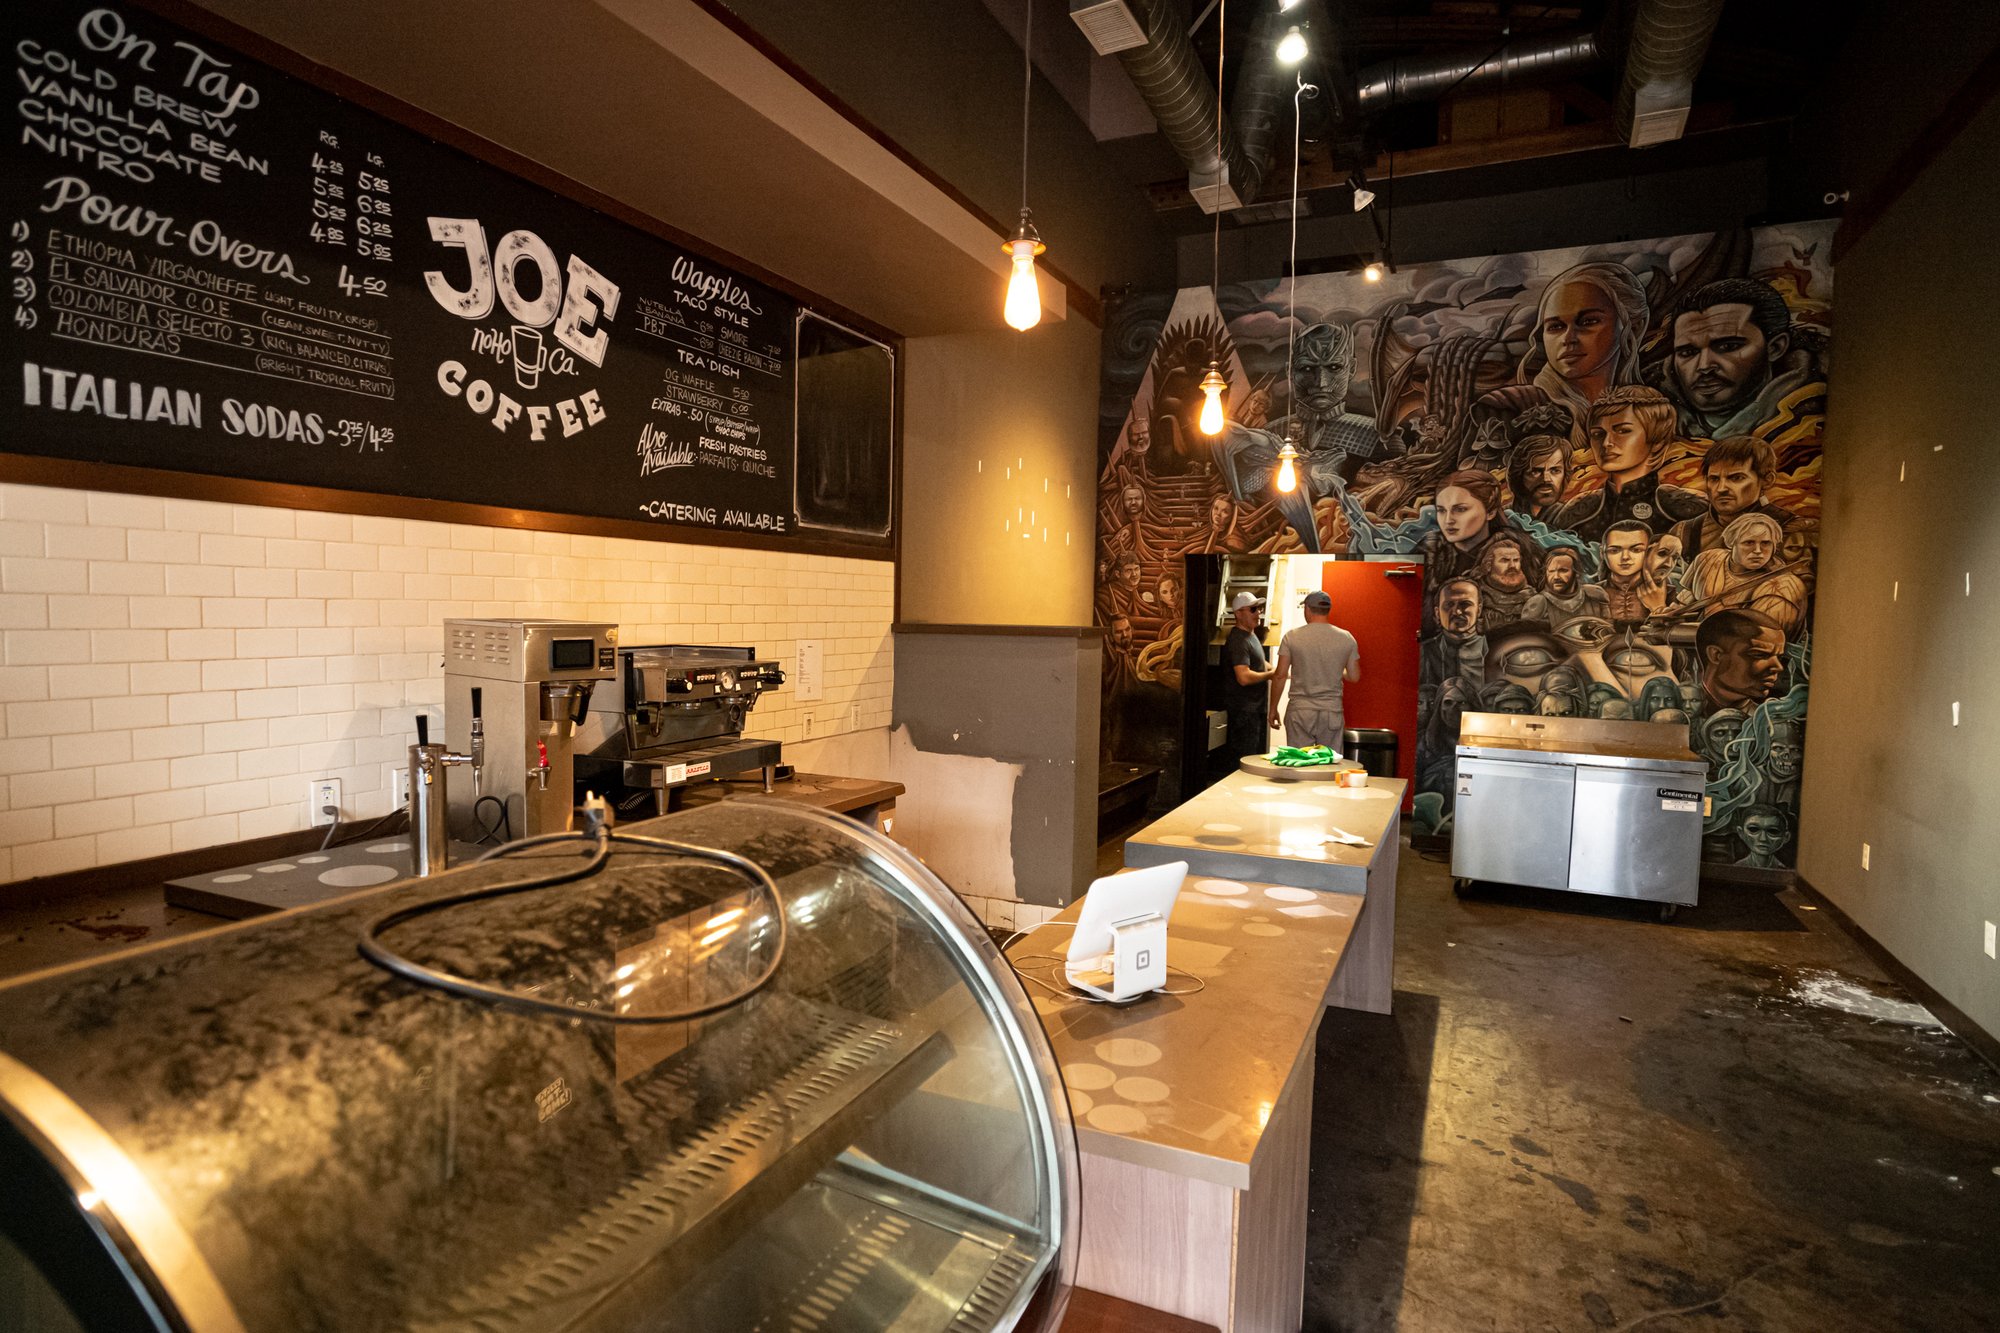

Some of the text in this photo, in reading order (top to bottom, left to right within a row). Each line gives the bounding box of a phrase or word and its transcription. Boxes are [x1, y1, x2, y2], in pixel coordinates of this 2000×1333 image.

[78, 9, 260, 118] On Tap
[17, 40, 237, 137] COLD BREW
[18, 67, 268, 175] VANILLA BEAN
[18, 99, 222, 183] CHOCOLATE
[23, 125, 155, 182] NITRO
[48, 229, 136, 270] ETHIOPIA
[50, 256, 77, 282] EL
[83, 266, 177, 306] SALVADOR
[423, 216, 621, 369] JOE
[671, 256, 763, 316] Waffles
[48, 284, 150, 326] COLOMBIA
[157, 309, 233, 341] SELECTO
[639, 296, 683, 318] NUTELLA
[644, 316, 667, 336] PBJ
[645, 306, 686, 326] BANANA
[674, 290, 750, 328] TACO STYLE
[56, 311, 181, 355] HONDURAS
[23, 362, 202, 429] ITALIAN
[222, 398, 325, 445] SODAS
[437, 360, 607, 441] COFFEE
[666, 385, 723, 411] STRAWBERRY
[682, 373, 715, 392] WAFFLE
[651, 397, 681, 416] EXTRAS
[699, 436, 767, 461] FRESH PASTRIES
[742, 460, 776, 478] QUICHE
[722, 510, 785, 532] AVAILABLE
[1660, 788, 1699, 800] Continental
